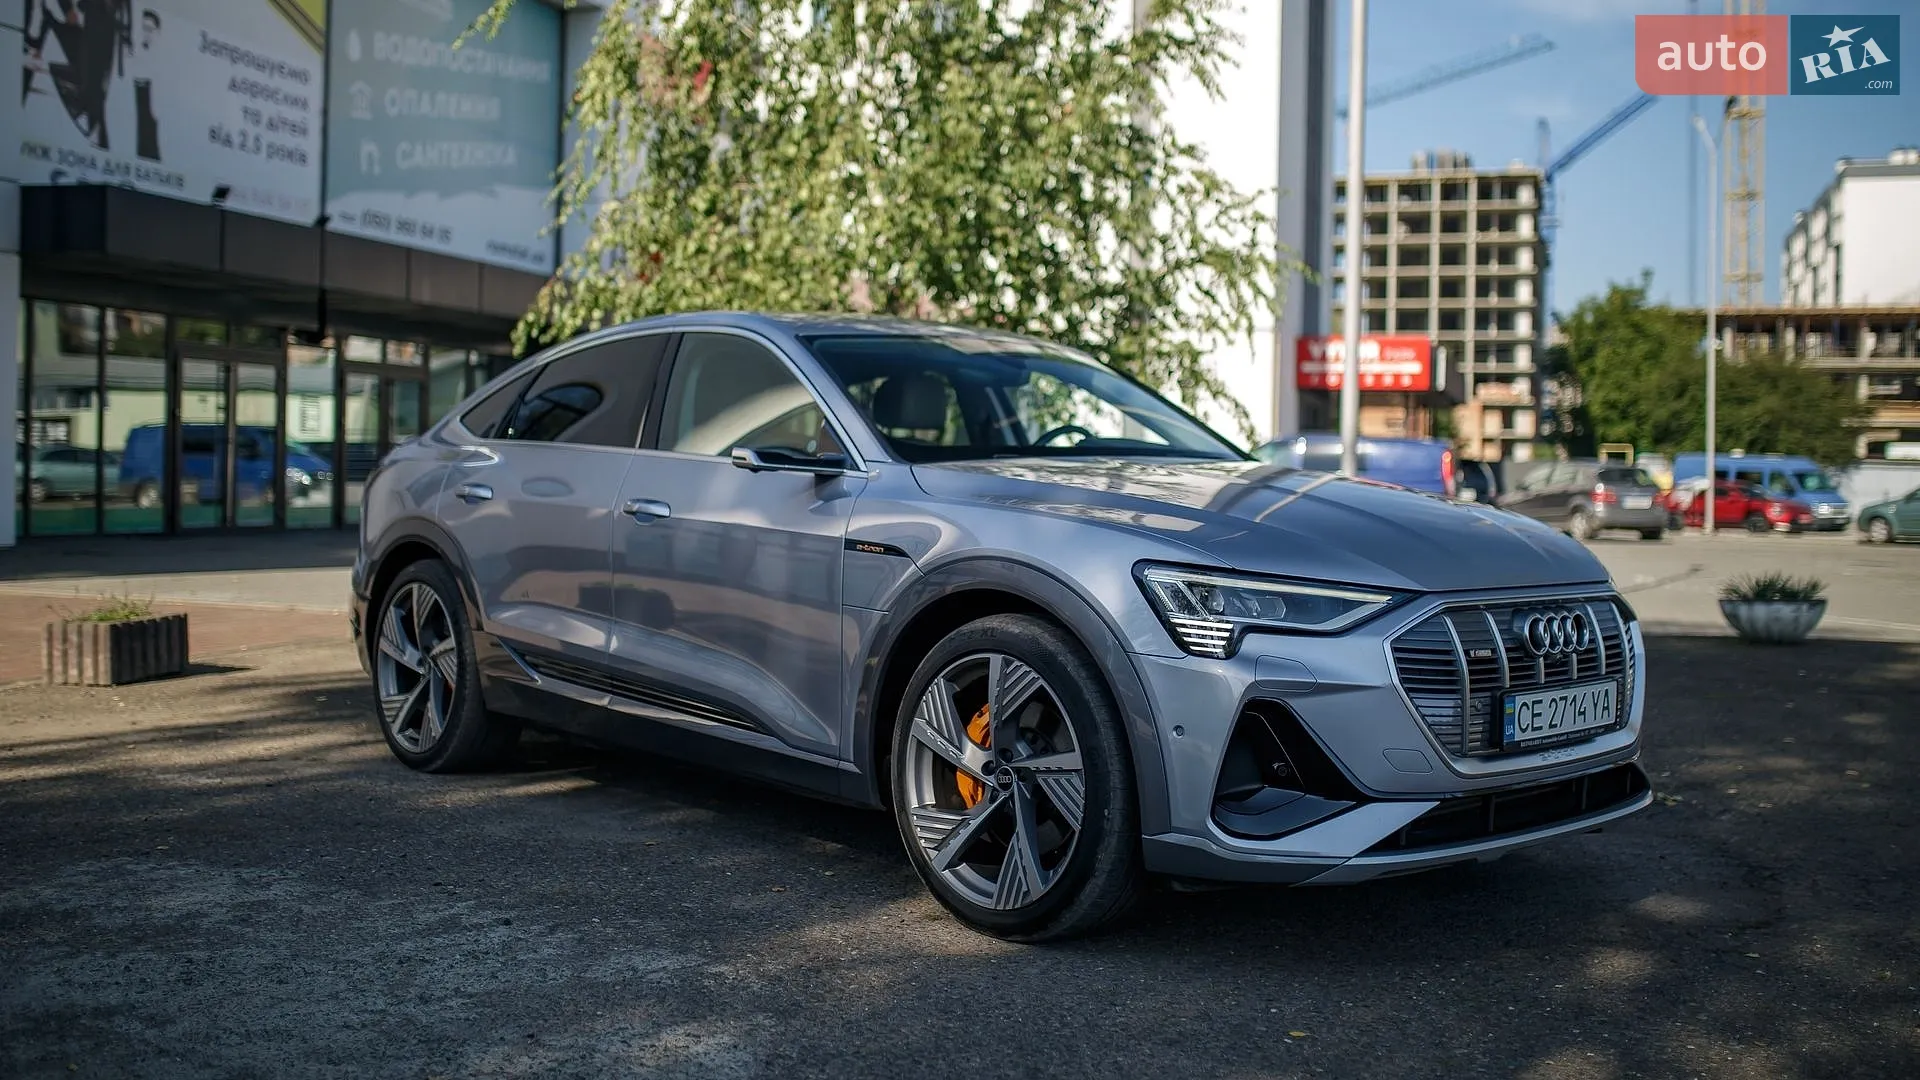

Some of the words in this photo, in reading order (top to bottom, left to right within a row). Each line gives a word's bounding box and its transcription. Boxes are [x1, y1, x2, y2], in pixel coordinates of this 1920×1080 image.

[199, 30, 311, 86] Запрошуємо
[373, 31, 550, 83] ВОДОПОСТАЧАННЯ
[228, 76, 310, 113] дорослих
[384, 87, 500, 121] ОПАЛЕННЯ
[208, 123, 233, 149] від
[265, 141, 308, 167] років
[396, 140, 518, 170] САНТЕХНІКА
[856, 544, 884, 553] e-tron
[1518, 699, 1543, 733] CE
[1548, 691, 1587, 730] 2714
[1592, 688, 1610, 721] YA
[1505, 725, 1514, 736] UA
